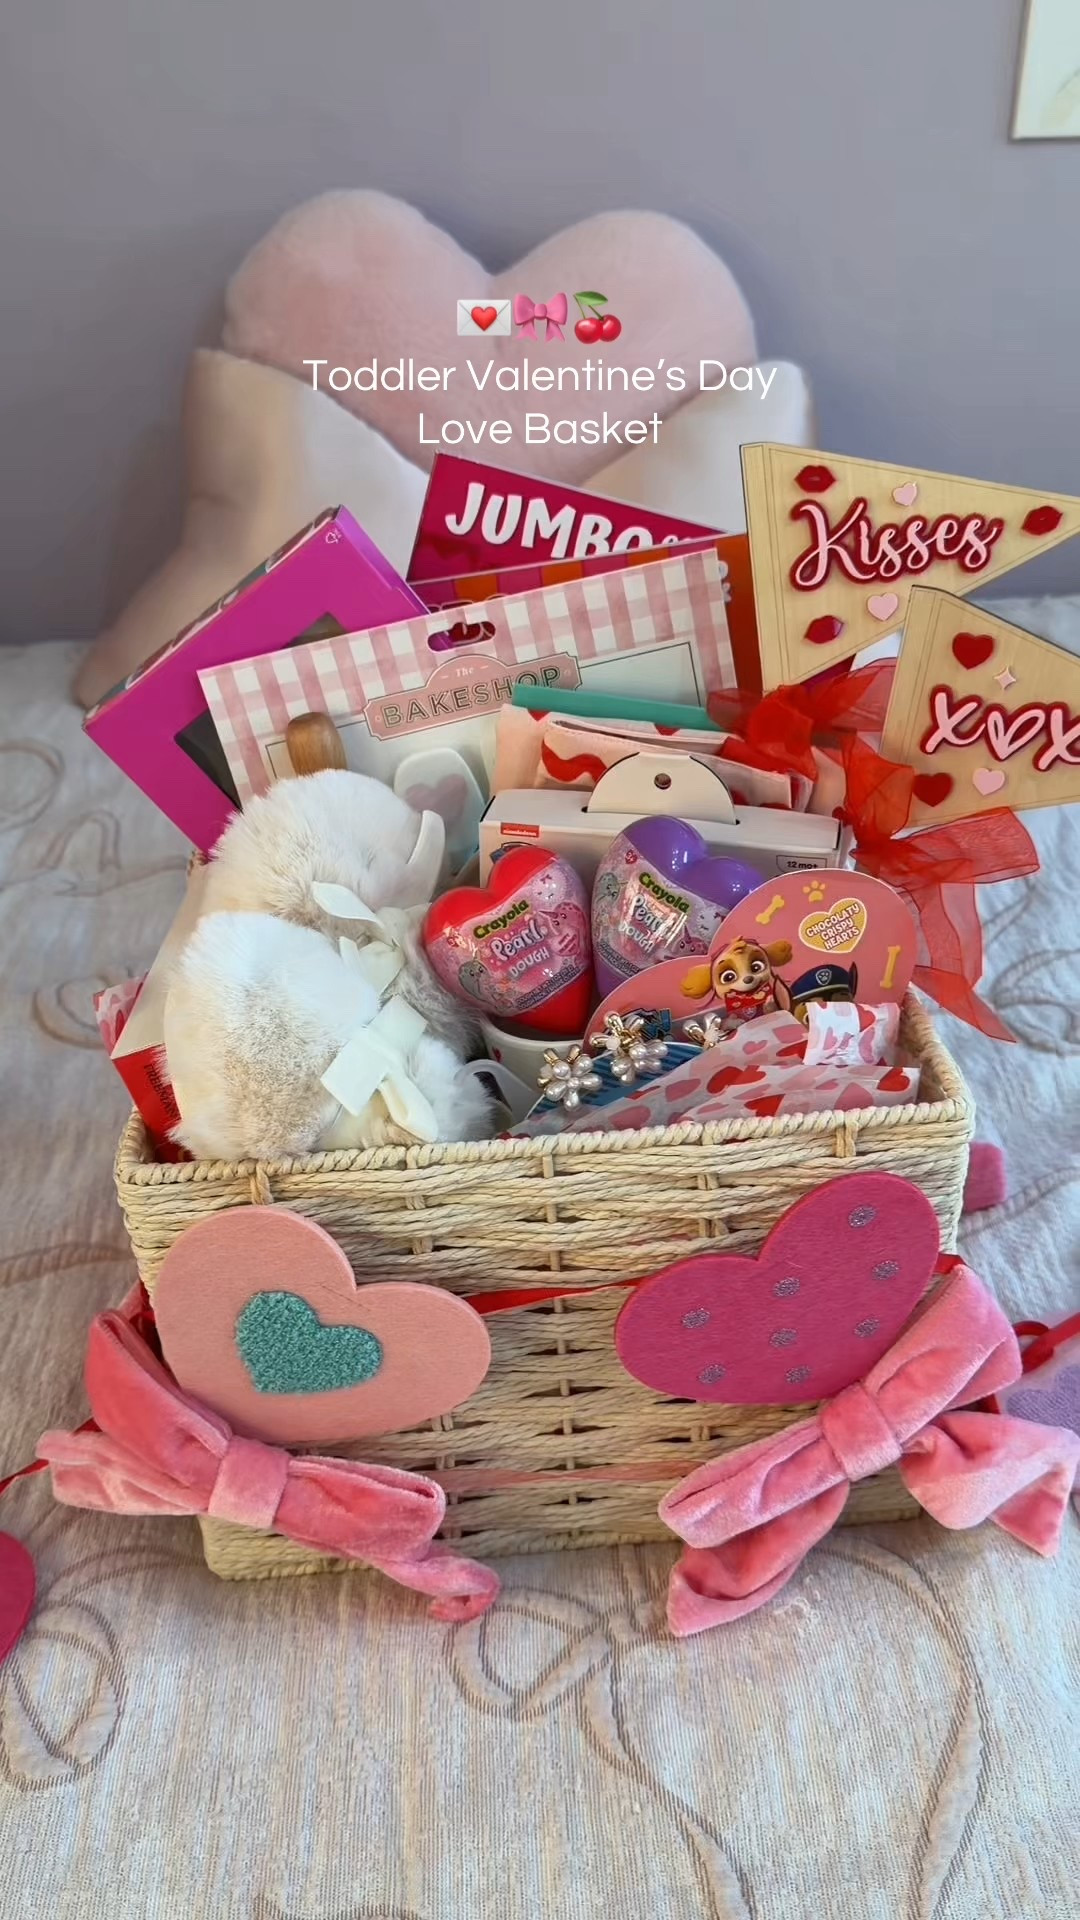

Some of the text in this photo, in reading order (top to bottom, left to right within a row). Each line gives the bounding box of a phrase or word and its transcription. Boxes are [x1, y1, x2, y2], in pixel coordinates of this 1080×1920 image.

[791, 498, 1003, 590] Kisses
[455, 666, 475, 678] The
[639, 871, 690, 913] Crayola
[473, 900, 530, 940] Crayola
[618, 919, 655, 954] DOUGH
[805, 903, 860, 937] CHOCOLATY
[821, 918, 854, 941] CRISPY
[490, 918, 543, 962] Pearl
[824, 926, 860, 951] HEARTS
[510, 946, 550, 979] DOUGH
